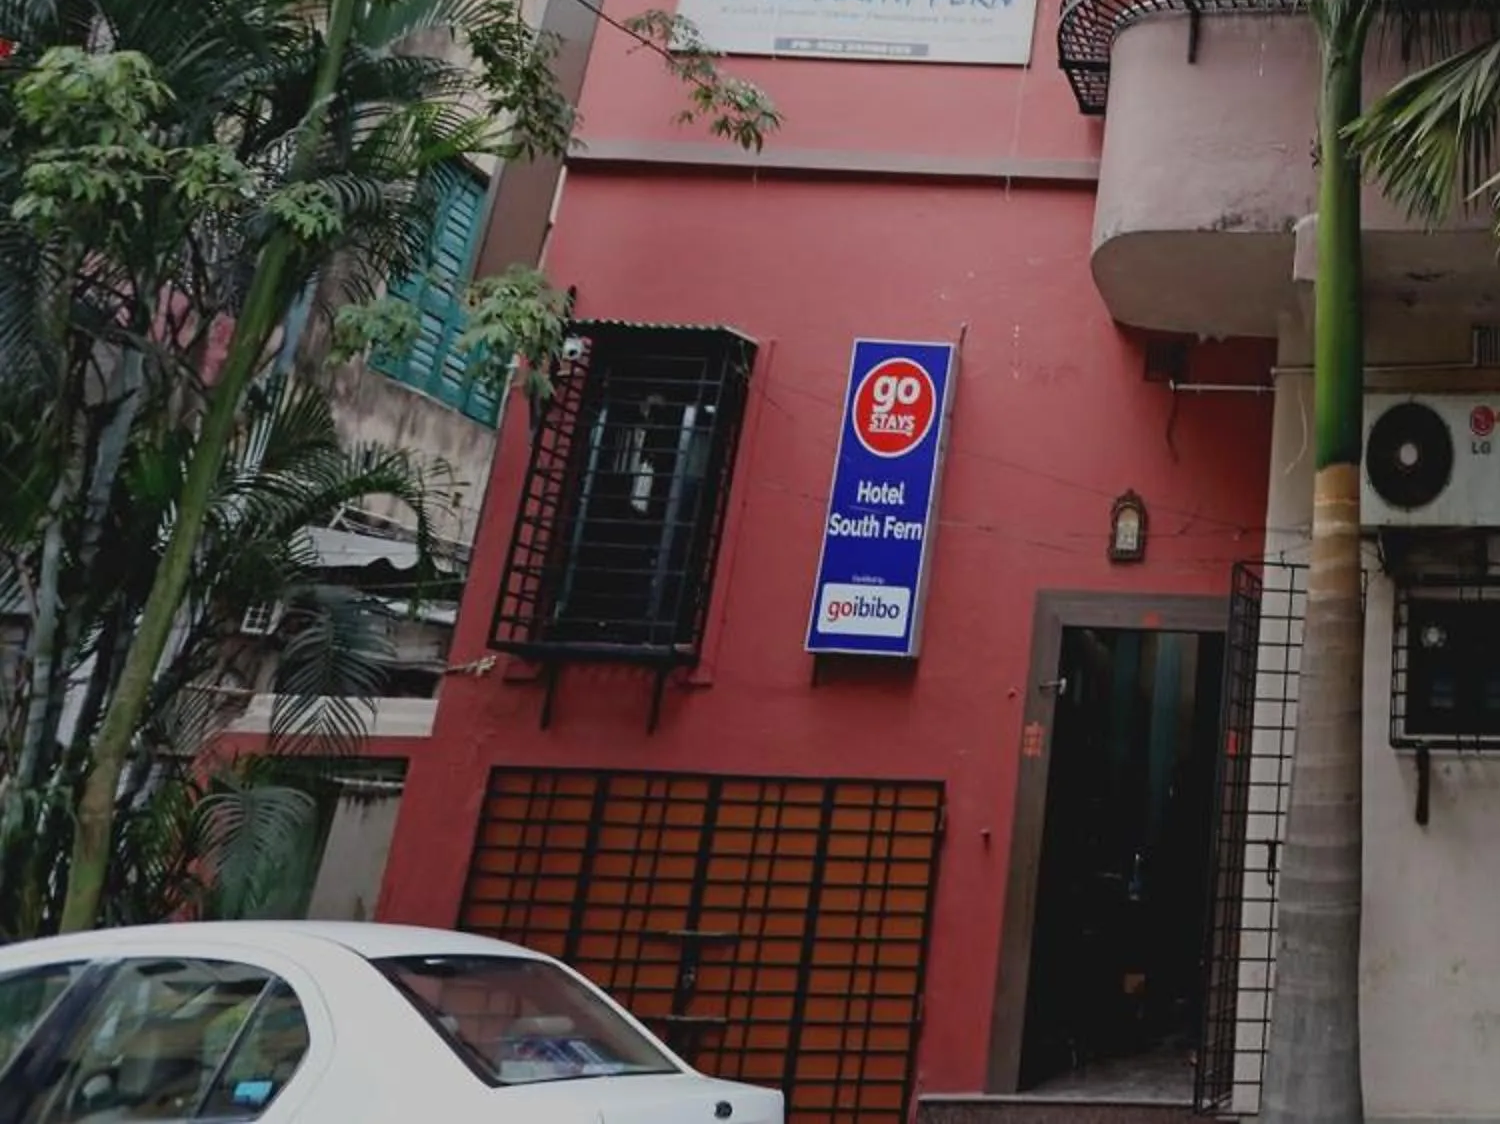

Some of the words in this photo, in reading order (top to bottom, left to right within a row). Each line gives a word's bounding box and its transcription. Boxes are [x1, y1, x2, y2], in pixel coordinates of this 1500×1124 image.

[872, 375, 920, 413] go
[869, 413, 915, 430] STAYS
[1471, 441, 1492, 455] LG
[856, 480, 905, 505] Hotel
[827, 512, 880, 538] South
[883, 515, 922, 541] Fern
[826, 596, 900, 621] goibibo
